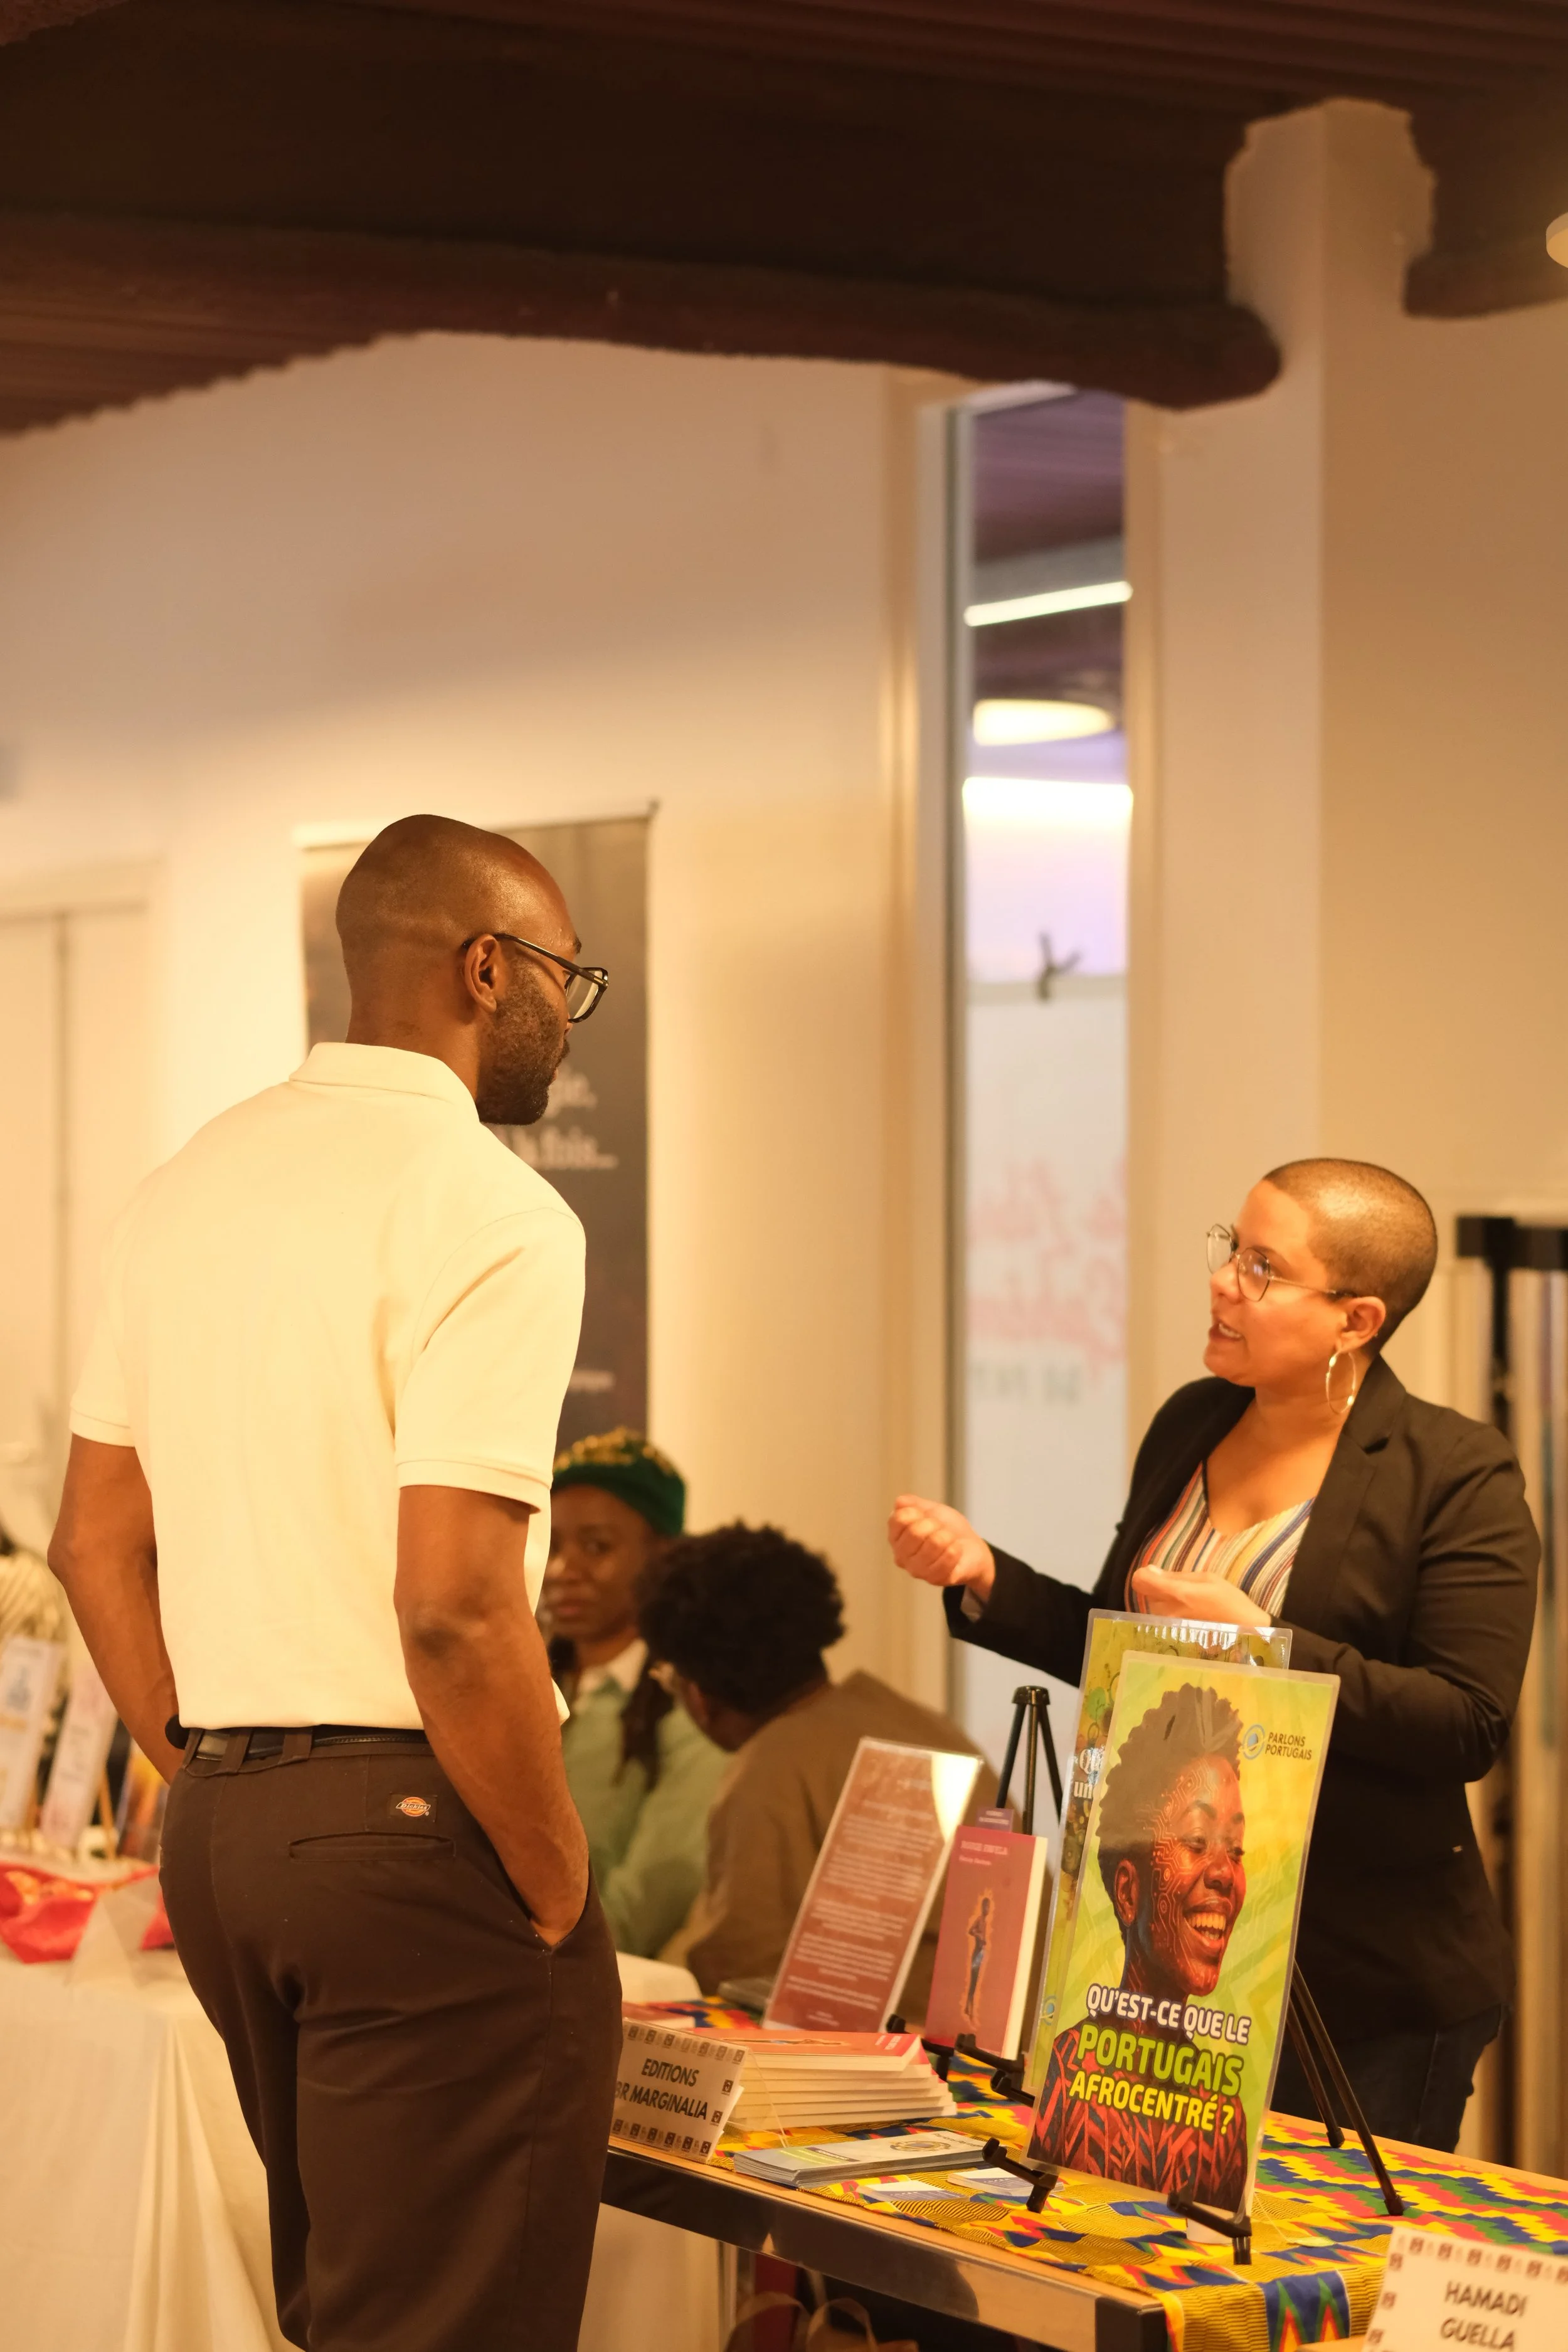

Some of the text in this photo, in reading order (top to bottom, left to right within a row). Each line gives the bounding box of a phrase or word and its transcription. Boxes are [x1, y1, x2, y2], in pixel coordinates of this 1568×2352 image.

[1264, 1744, 1313, 1761] PORTUGAIS
[1267, 1732, 1306, 1747] PARLONS
[1086, 1984, 1251, 2045] QU'EST-CE QUE LE
[640, 2057, 701, 2087] EDITIONS
[1076, 2023, 1244, 2097] PORTUGAIS
[629, 2084, 708, 2120] MARGINALIA
[1068, 2070, 1218, 2132] AFROCENTRÉ
[1444, 2281, 1528, 2317] HAMADI
[1440, 2317, 1515, 2352] GUELLA
